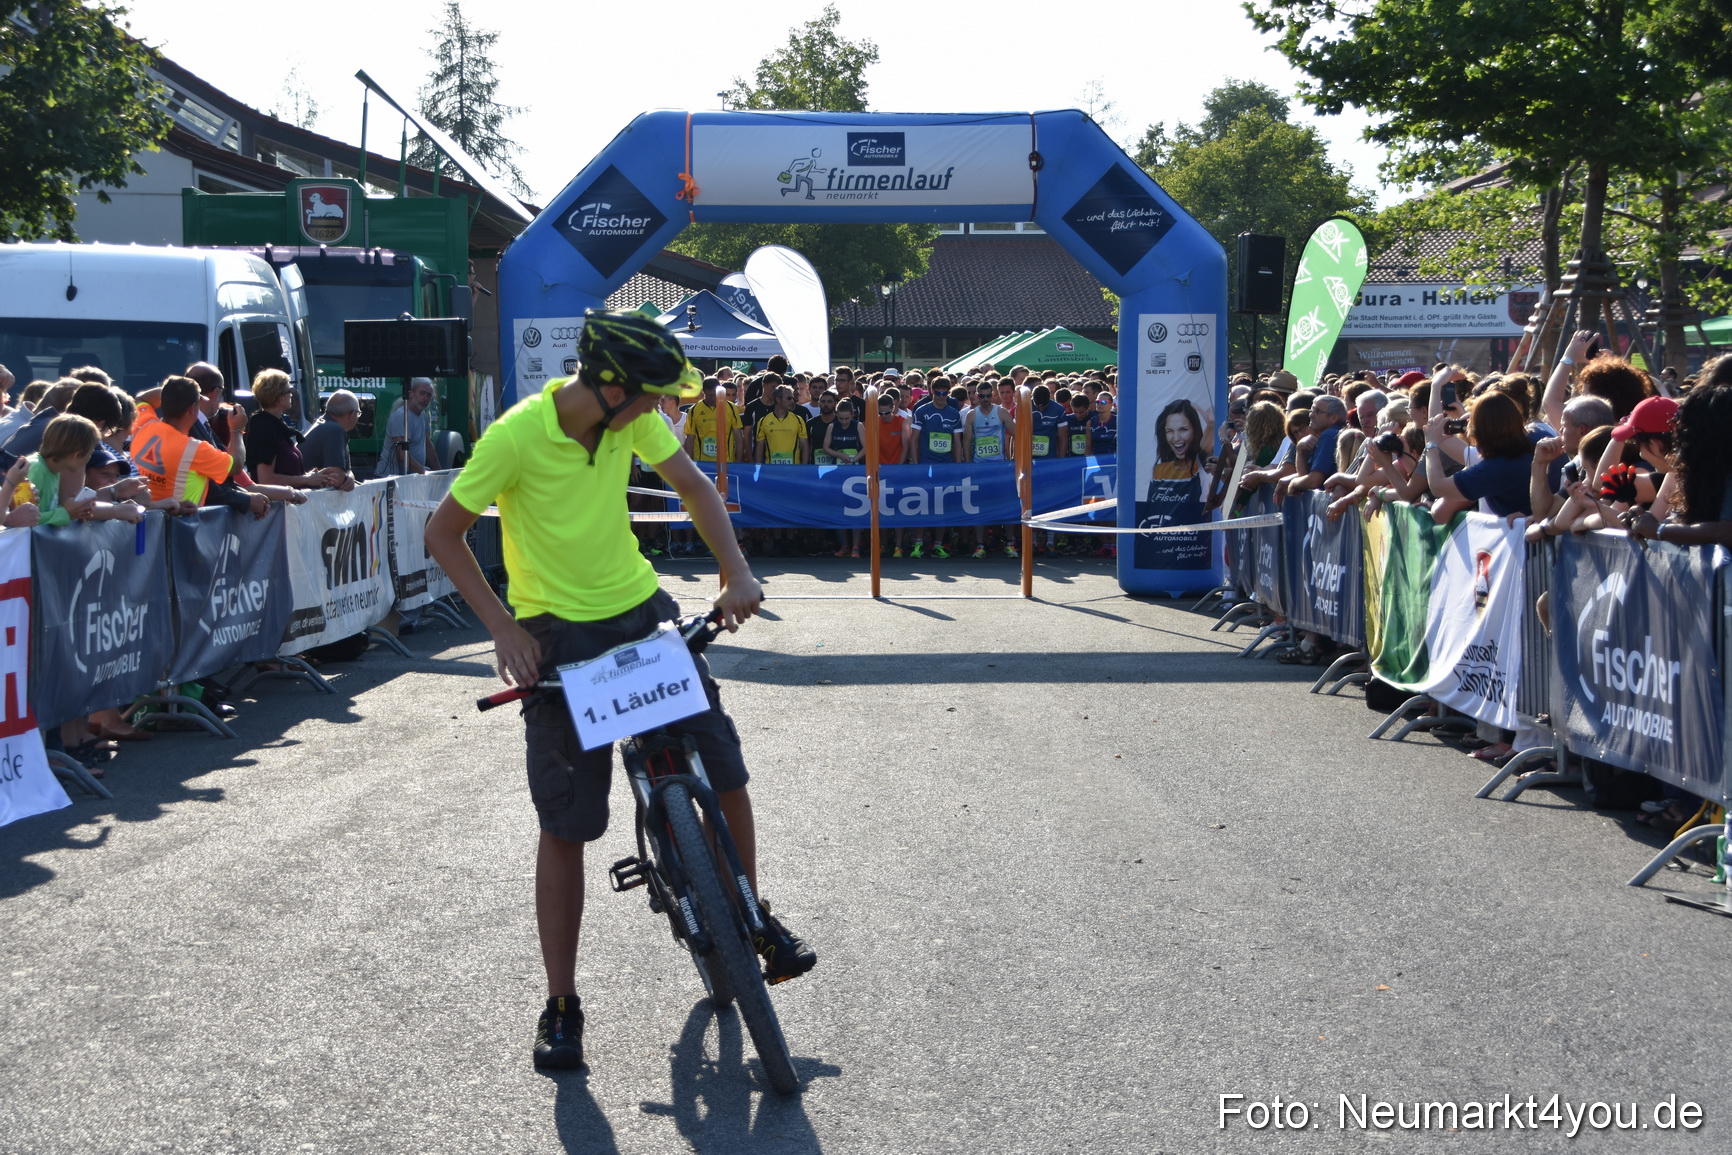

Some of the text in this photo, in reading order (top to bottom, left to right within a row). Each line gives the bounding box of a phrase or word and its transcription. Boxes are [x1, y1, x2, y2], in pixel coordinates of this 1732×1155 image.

[860, 144, 902, 154] Fischer
[827, 166, 955, 190] firmenlauf
[826, 191, 879, 200] neumarkt
[582, 214, 651, 228] Fischer
[1086, 211, 1105, 222] und
[1107, 208, 1125, 219] das
[314, 229, 337, 238] 1628
[588, 228, 645, 236] AUTOMOBILE
[1354, 290, 1402, 307] Jura
[1443, 313, 1462, 322] grüßt
[1290, 306, 1326, 354] AOK
[1423, 322, 1467, 330] angenehmen
[682, 344, 758, 352] cher-automobile.de
[1359, 349, 1411, 360] Willkommen
[1188, 357, 1200, 368] FIAT
[1370, 357, 1415, 367] in meinem
[933, 440, 948, 448] 956
[978, 445, 999, 454] 5193
[842, 476, 980, 517] Start
[86, 595, 149, 655] Fischer
[609, 653, 661, 678] firmenlauf
[1592, 628, 1681, 705] Fischer
[584, 677, 691, 724] 1. Läufer
[1601, 700, 1673, 744] AUTOMOBILE
[679, 896, 700, 935] ROCKSHOX
